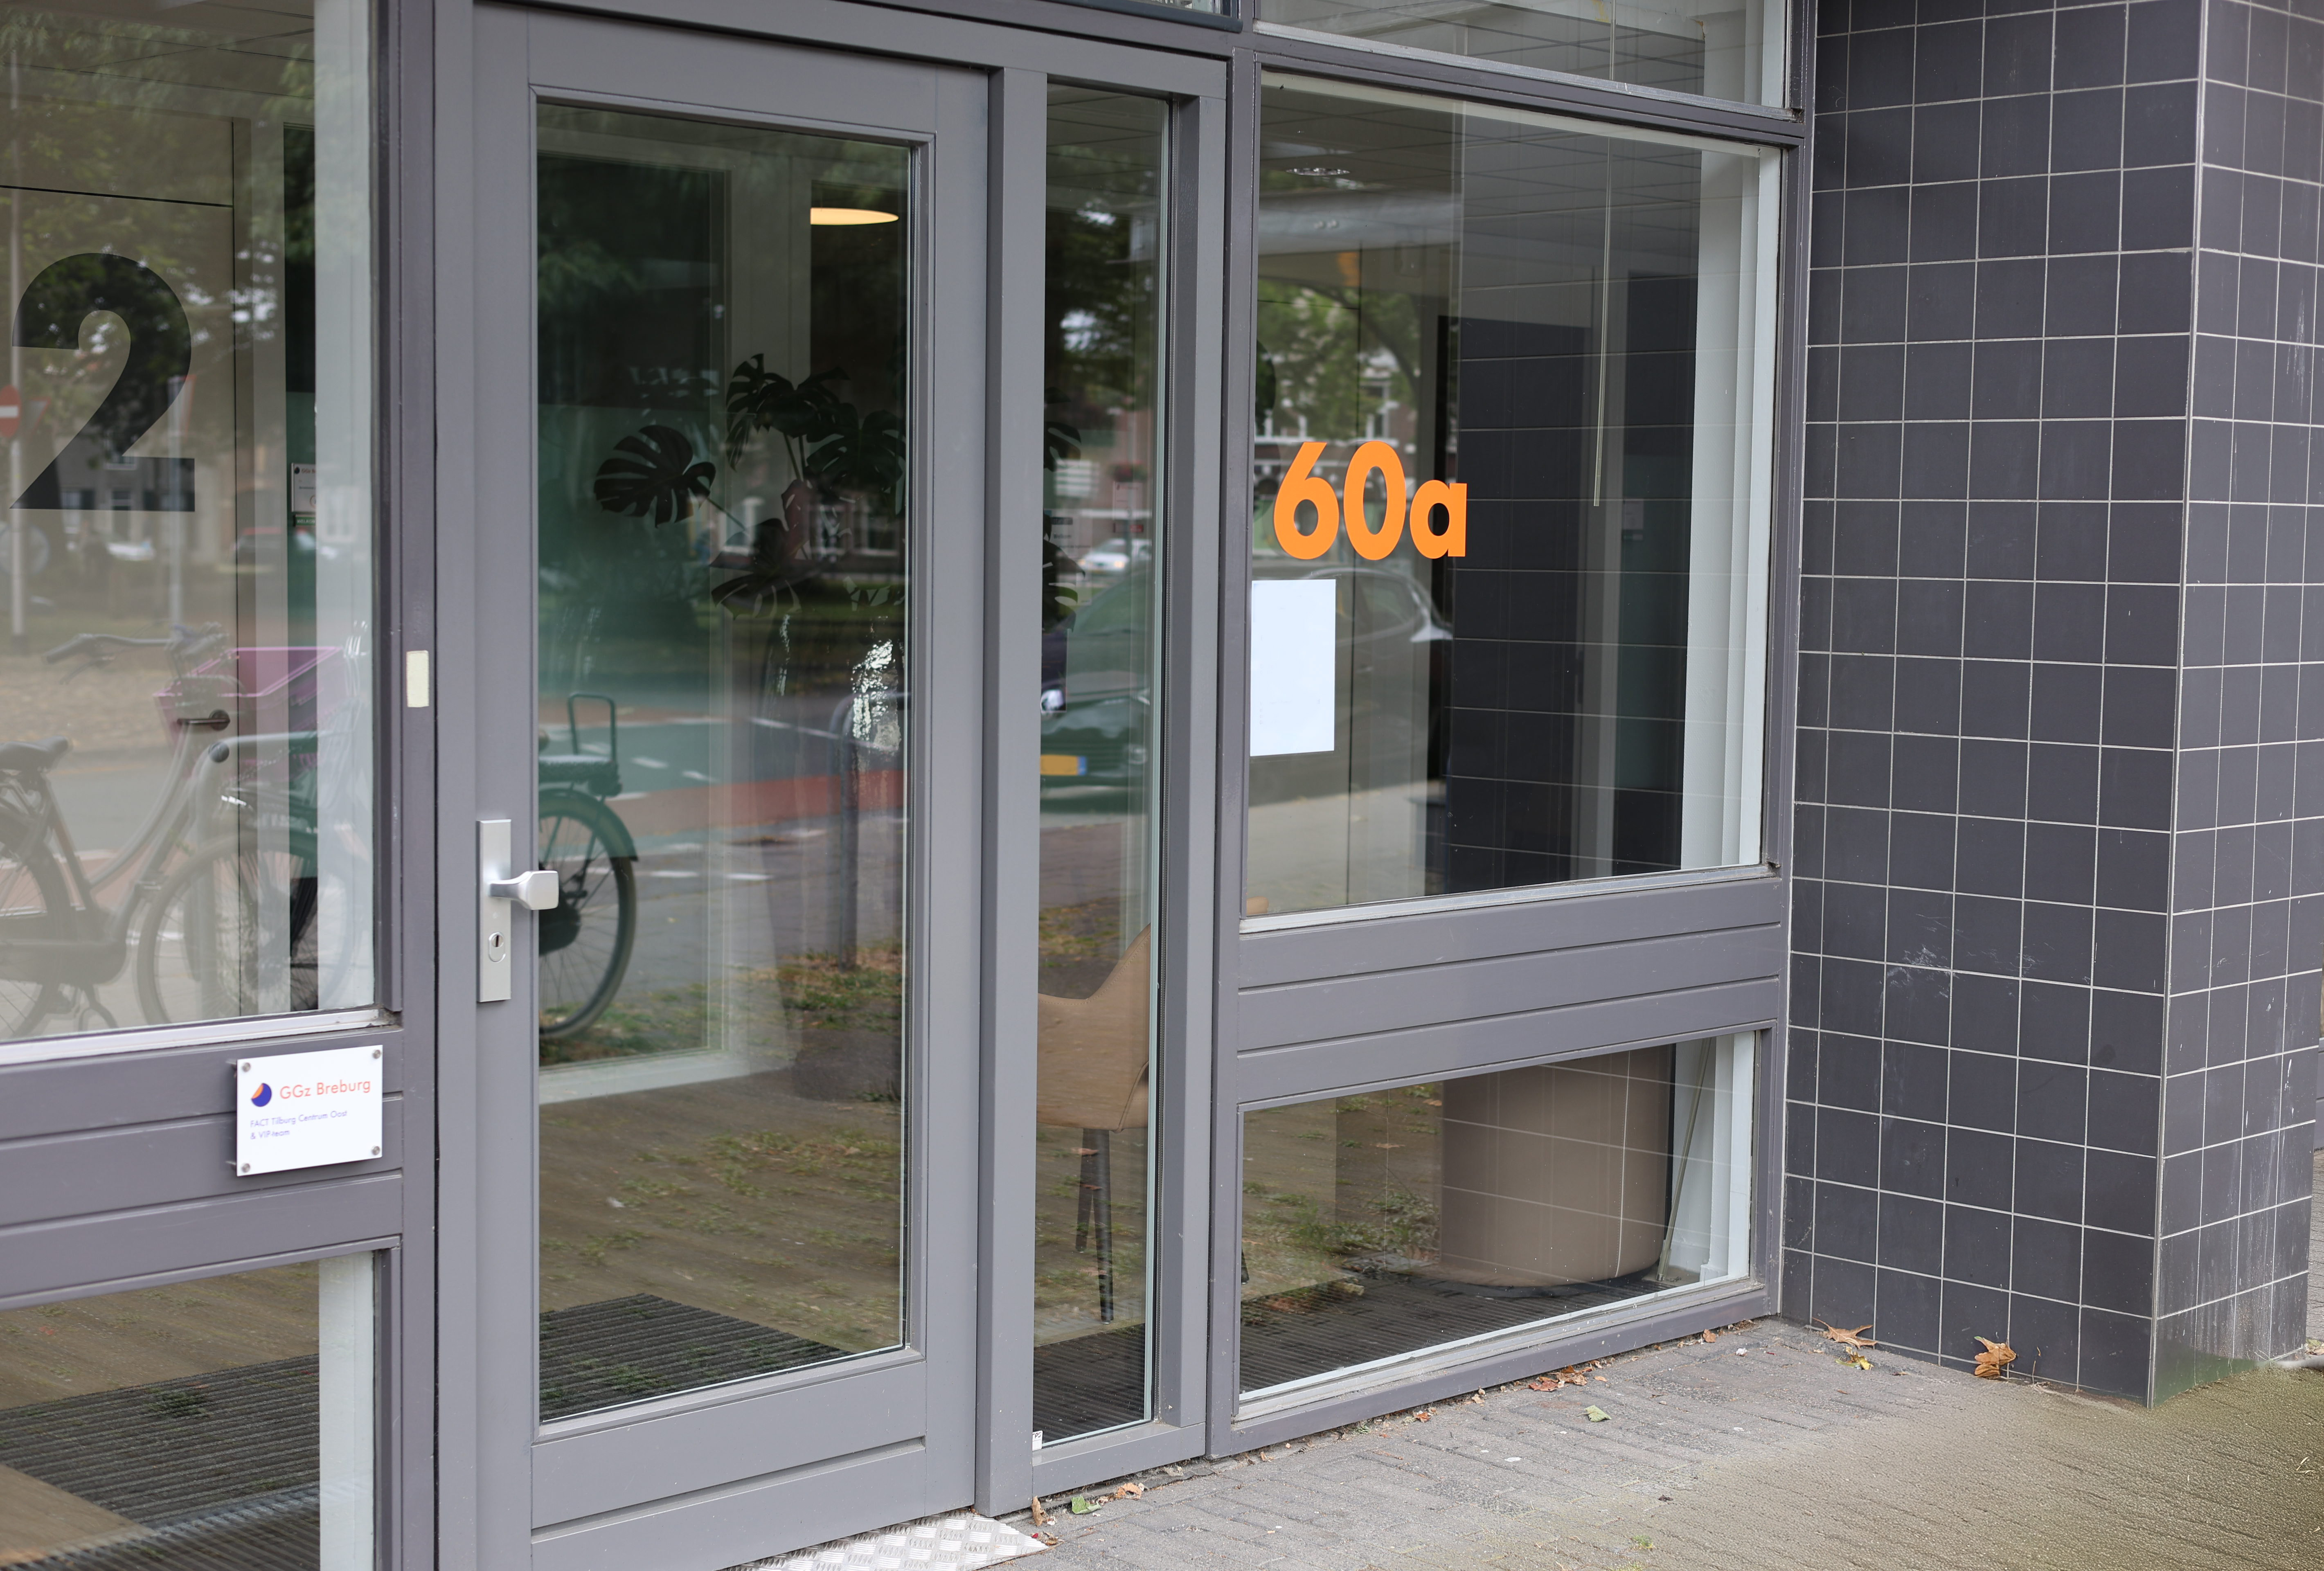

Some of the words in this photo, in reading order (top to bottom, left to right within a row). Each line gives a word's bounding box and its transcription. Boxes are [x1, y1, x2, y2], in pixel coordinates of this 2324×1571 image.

[9, 253, 195, 512] 2
[1273, 440, 1467, 560] 60a
[250, 1119, 269, 1128] FACT
[271, 1116, 296, 1125] Tilburg
[280, 1085, 311, 1099] GGz
[317, 1079, 371, 1093] Breburg
